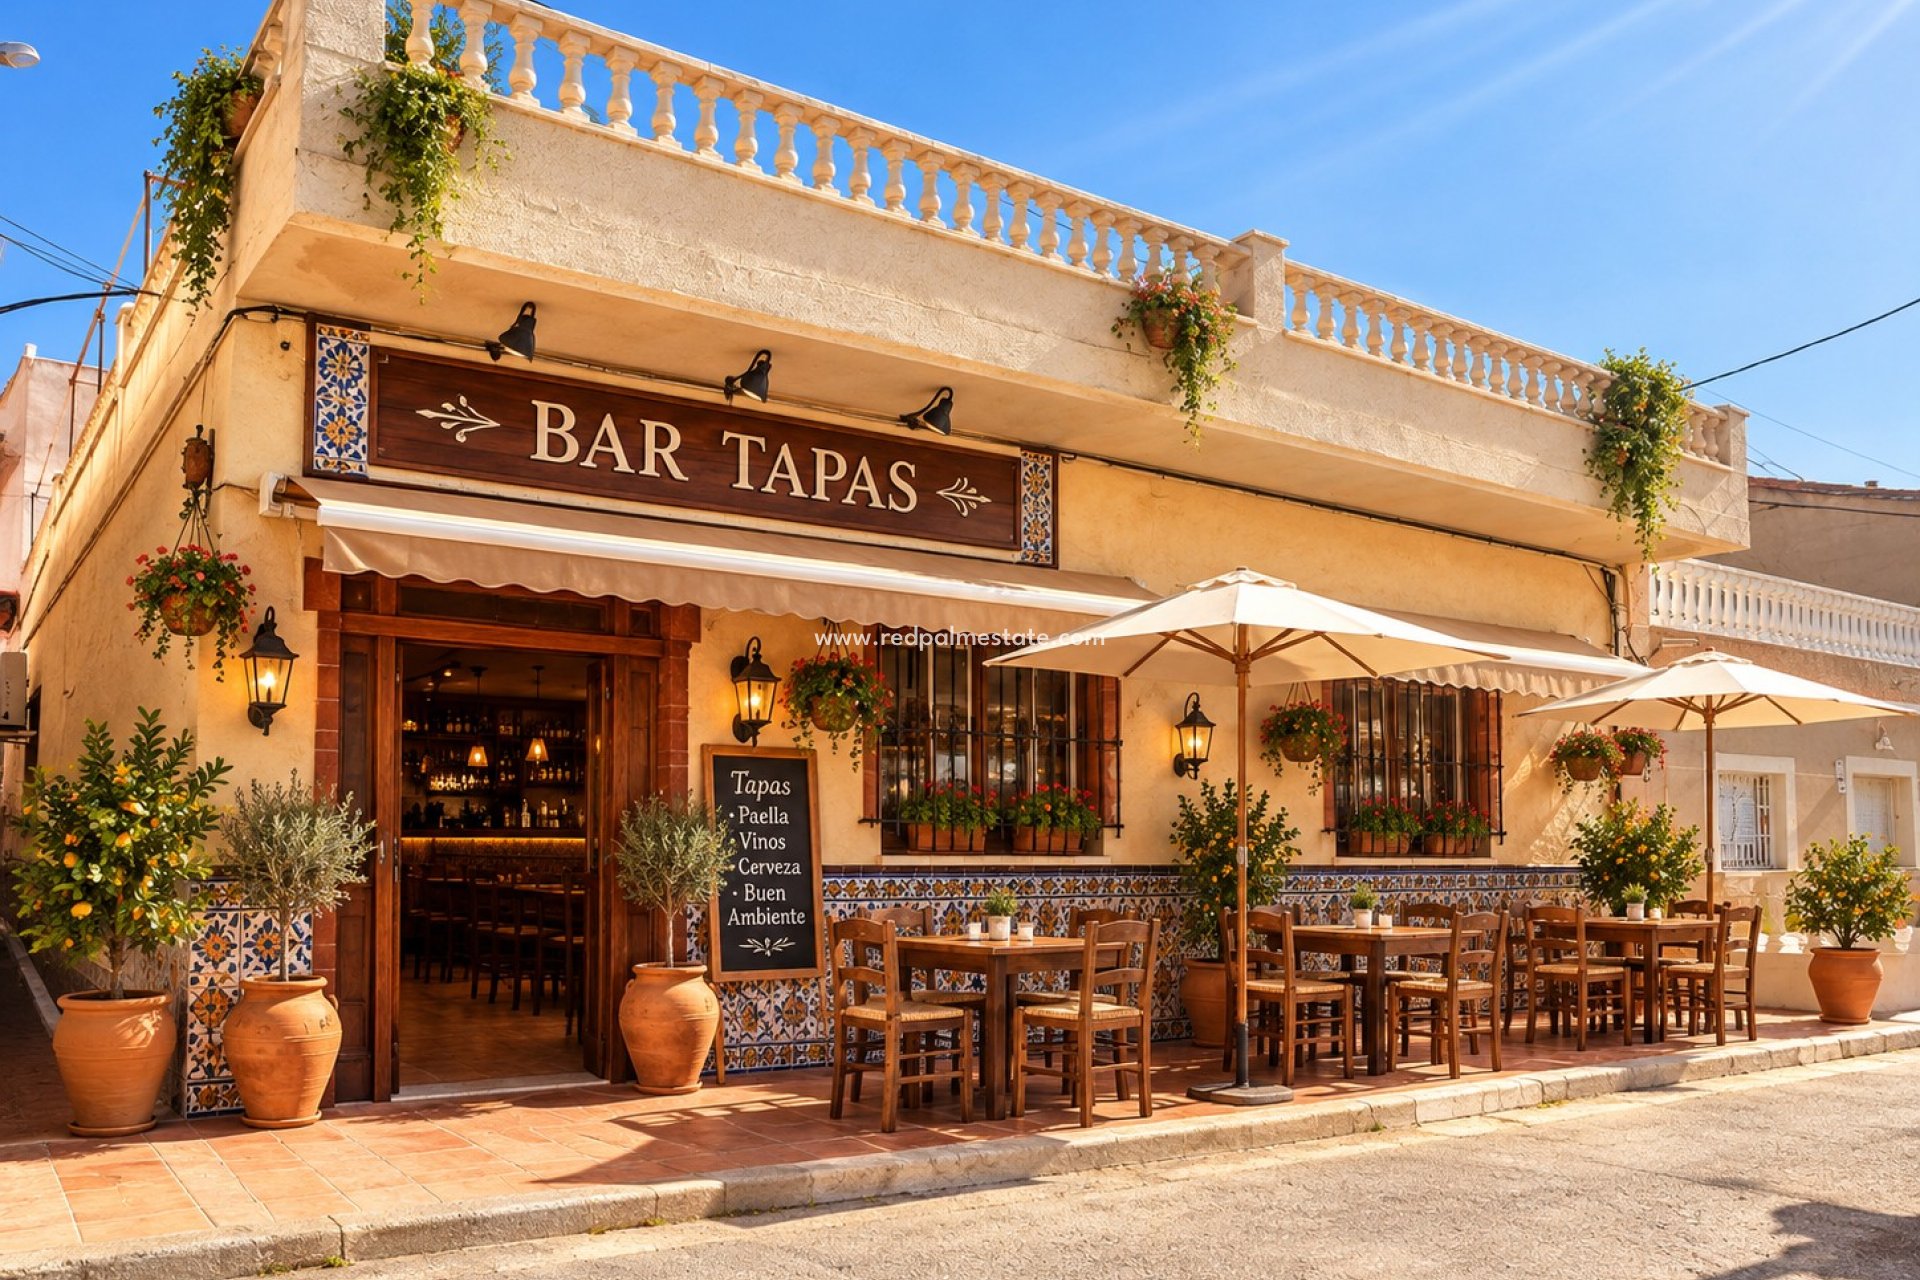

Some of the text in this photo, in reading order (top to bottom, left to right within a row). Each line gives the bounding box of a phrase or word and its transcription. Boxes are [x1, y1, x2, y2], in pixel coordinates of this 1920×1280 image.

[530, 400, 917, 513] BAR TAPAS
[731, 770, 791, 801] Tapas
[738, 805, 790, 825] Paella
[739, 831, 786, 850] Vinos
[738, 857, 802, 876] Cerveza
[744, 883, 786, 902] Buen
[727, 907, 806, 926] Ambiente
